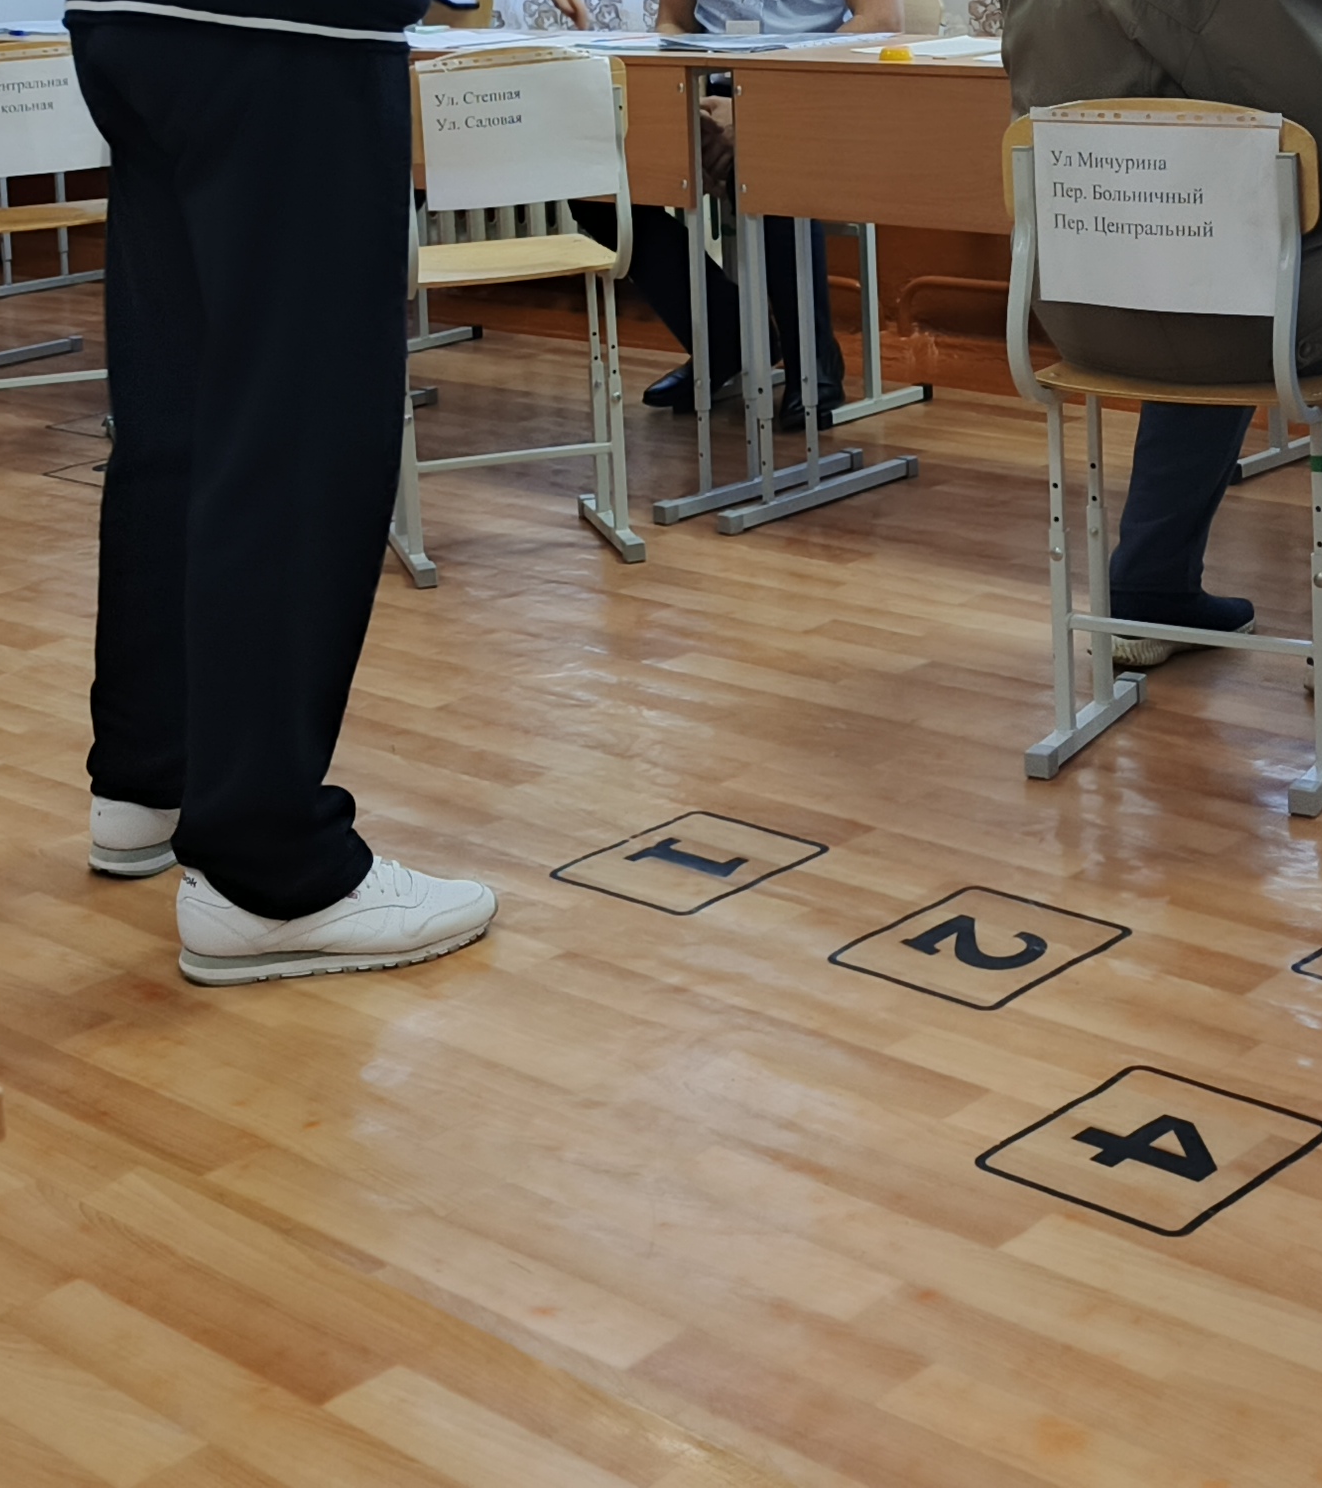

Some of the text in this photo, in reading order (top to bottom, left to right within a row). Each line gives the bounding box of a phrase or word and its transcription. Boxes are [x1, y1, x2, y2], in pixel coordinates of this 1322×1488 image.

[434, 90, 521, 107] Ул. Степная
[436, 114, 523, 131] Ул. Садовая
[1050, 150, 1167, 174] Ул Мичурина
[1052, 181, 1203, 205] Пер. Больничный
[1054, 213, 1214, 240] Пер. Центральный
[624, 837, 749, 878] 1
[900, 914, 1048, 970] 2
[1071, 1114, 1218, 1182] 4
